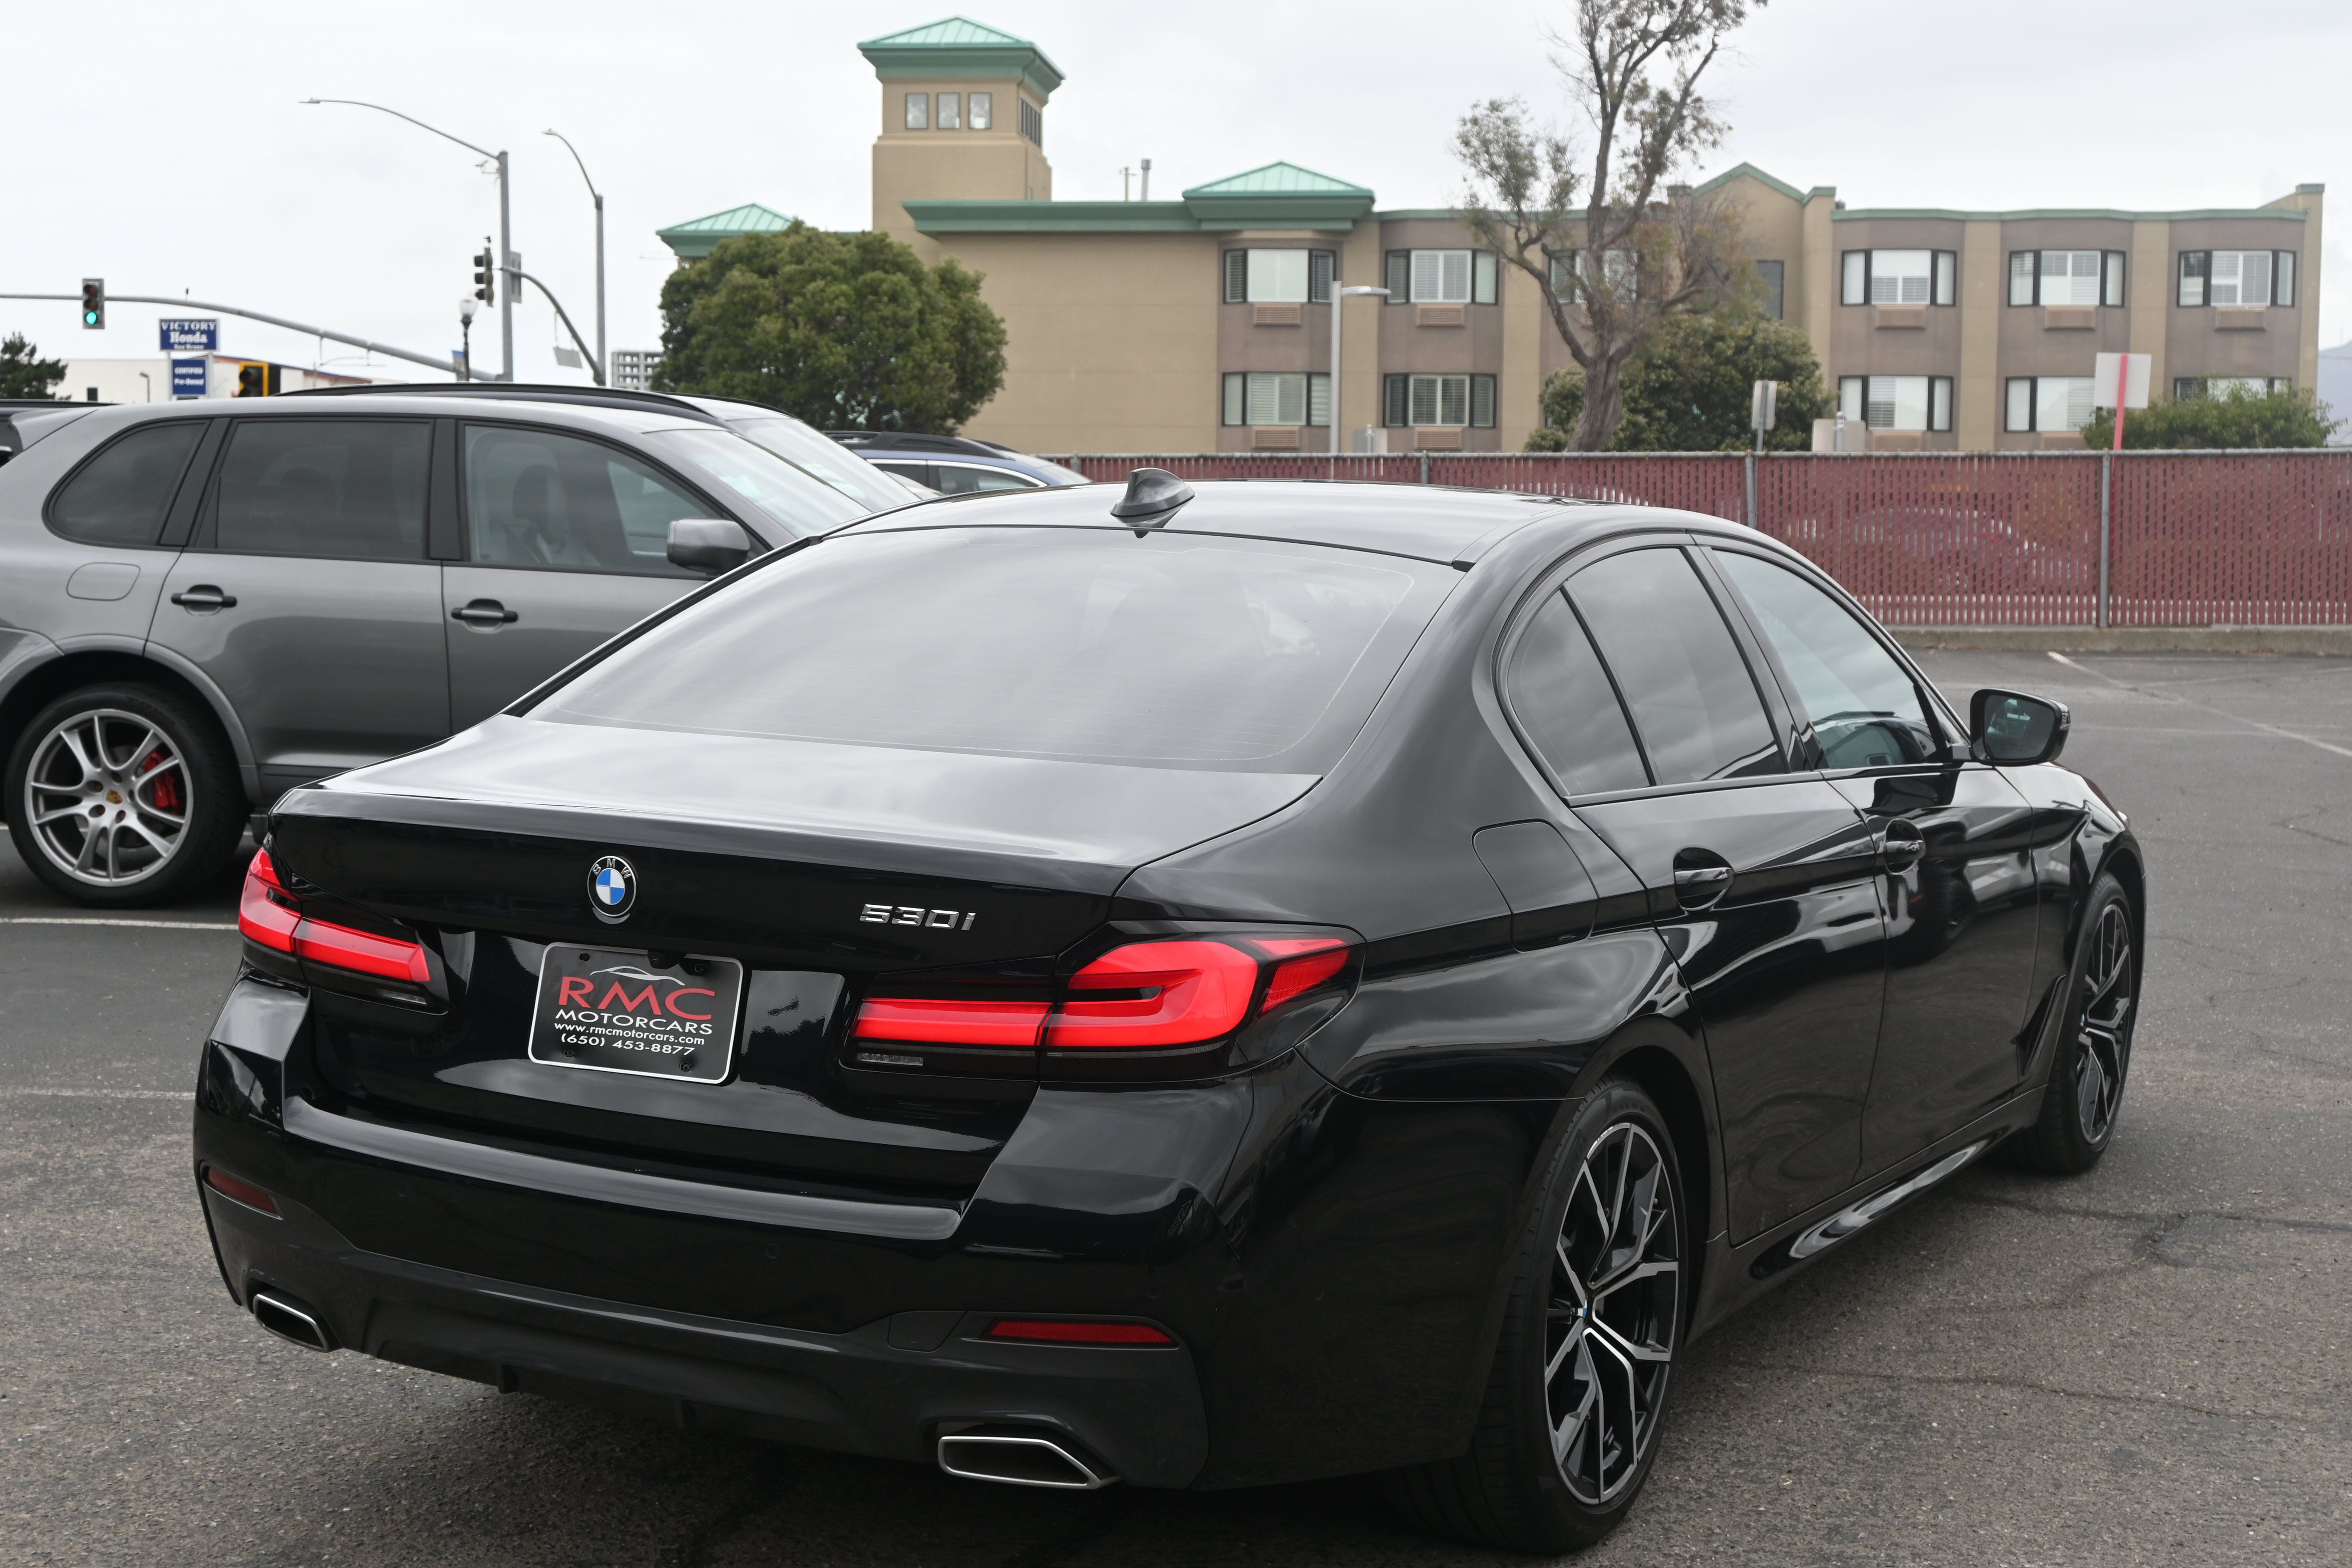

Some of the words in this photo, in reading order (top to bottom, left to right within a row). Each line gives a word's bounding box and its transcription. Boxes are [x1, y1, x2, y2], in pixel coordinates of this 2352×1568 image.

[161, 321, 216, 331] VICTORY
[170, 331, 208, 343] Honda
[592, 858, 632, 879] BMW
[859, 904, 977, 931] 530i
[558, 976, 716, 1021] RMC
[555, 1008, 713, 1035] MOTORCARS
[554, 1022, 705, 1045] www.rmcmotorcars.com
[561, 1033, 605, 1047] (650)
[612, 1040, 695, 1056] 453-8877
